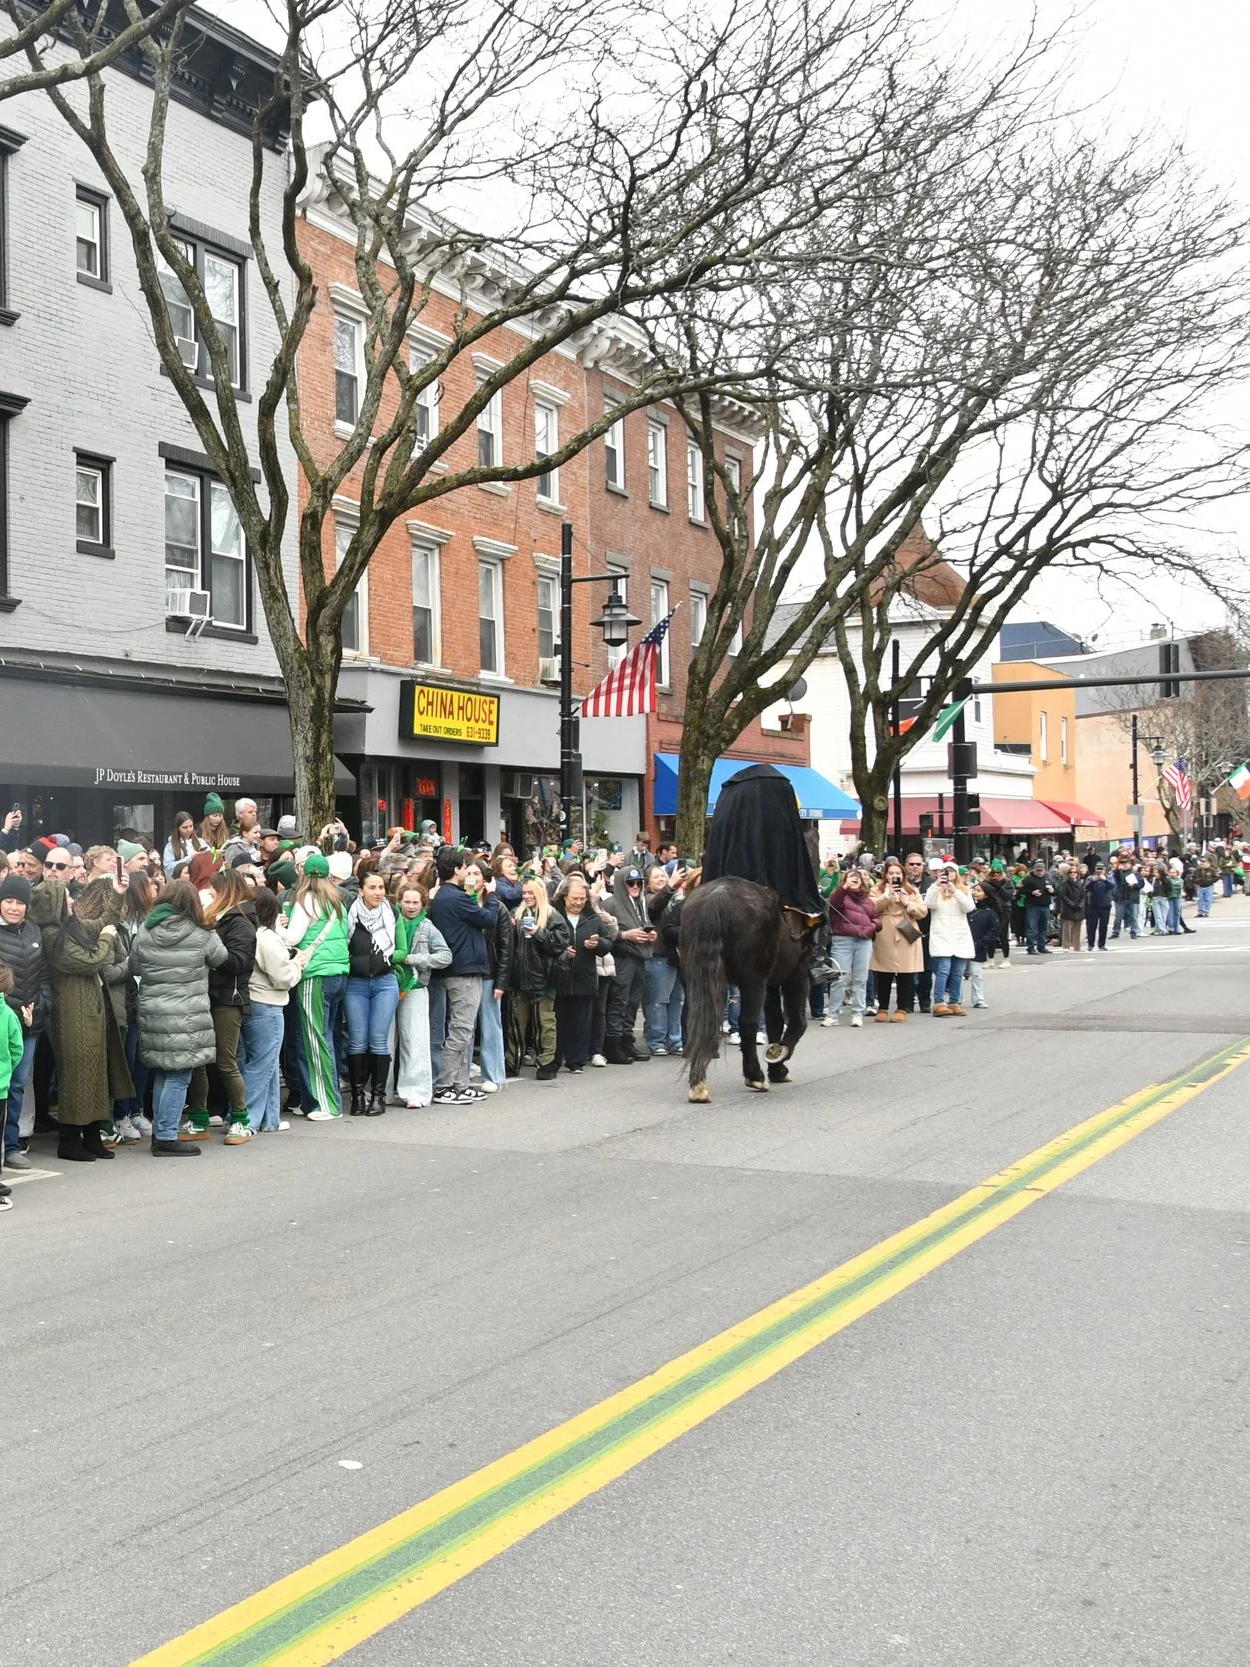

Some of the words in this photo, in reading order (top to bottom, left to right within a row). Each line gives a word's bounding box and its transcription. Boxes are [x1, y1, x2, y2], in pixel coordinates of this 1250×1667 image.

[417, 688, 455, 720] CHINA
[457, 694, 495, 726] HOUSE
[420, 723, 432, 734] TAKE
[432, 725, 443, 735] OUT
[443, 726, 463, 737] ORDERS
[94, 768, 105, 785] JP
[106, 769, 136, 783] DOYLE'S
[137, 771, 183, 784] RESTAURANT
[183, 772, 190, 785] &
[191, 772, 216, 786] PUBLIC
[217, 774, 240, 786] HOUSE
